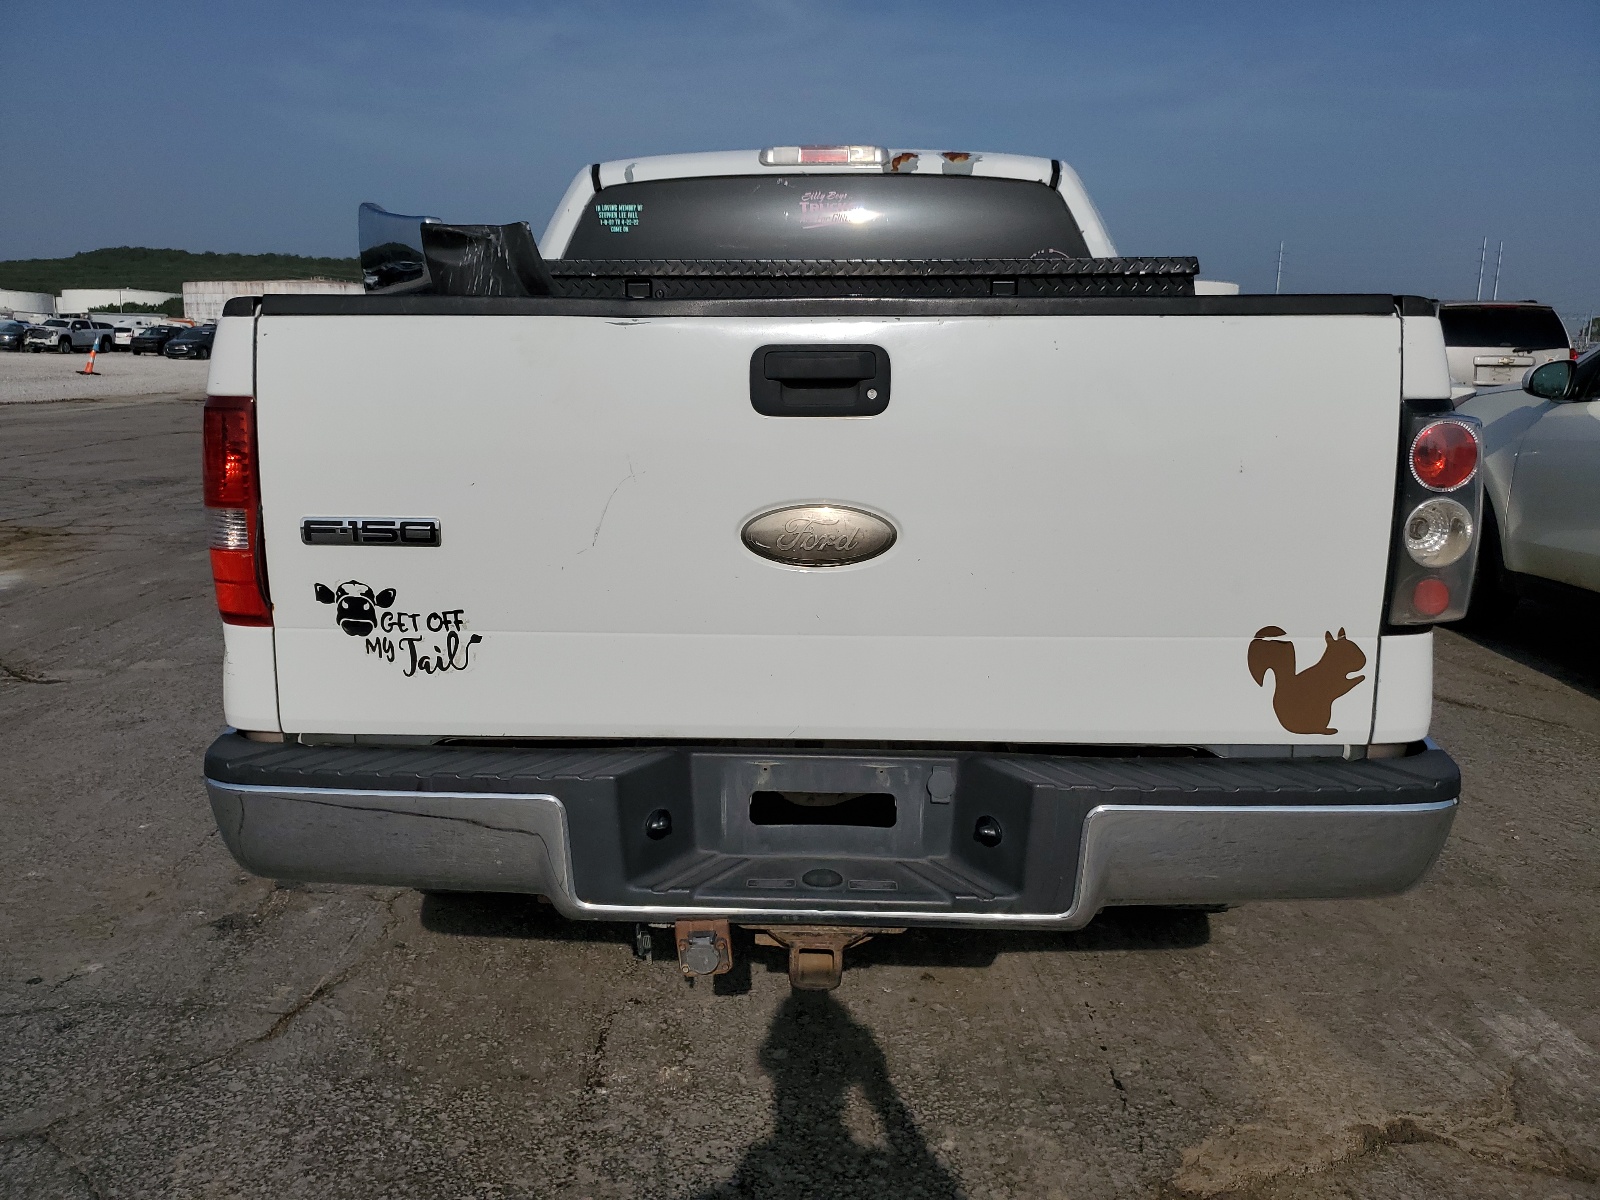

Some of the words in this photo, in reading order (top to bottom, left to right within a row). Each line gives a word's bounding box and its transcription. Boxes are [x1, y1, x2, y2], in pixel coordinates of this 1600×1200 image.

[801, 190, 826, 202] Silly
[598, 211, 618, 219] STEPHEN
[618, 211, 627, 219] LEE
[303, 520, 437, 543] F-150
[776, 517, 861, 552] Ford
[380, 611, 421, 633] GET
[426, 609, 465, 633] OFF
[398, 630, 483, 677] Tail
